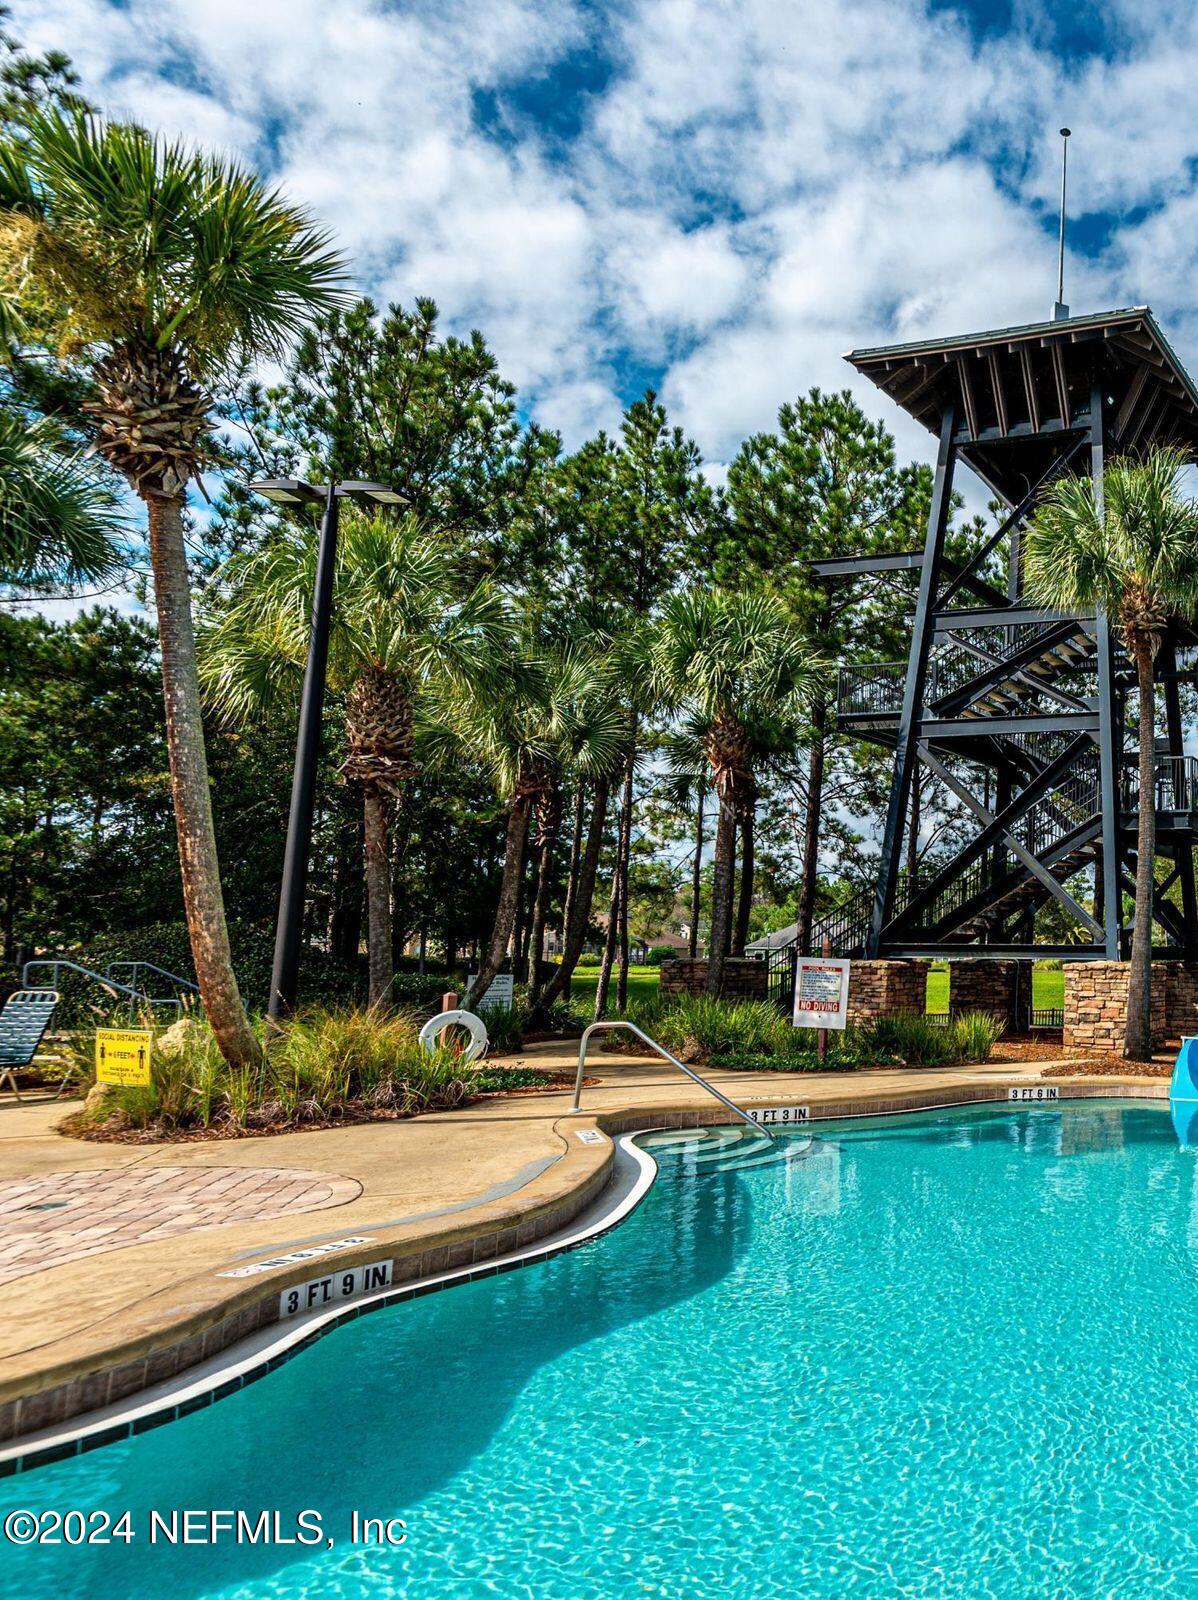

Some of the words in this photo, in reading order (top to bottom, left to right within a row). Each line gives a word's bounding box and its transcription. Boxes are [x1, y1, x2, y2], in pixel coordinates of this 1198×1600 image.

[800, 1001, 810, 1010] NO
[814, 1002, 838, 1012] DIVING
[117, 1034, 150, 1042] DISTANCING
[1012, 1090, 1018, 1098] 3
[1037, 1089, 1043, 1098] 6
[751, 1111, 758, 1121] 3
[783, 1109, 790, 1120] 3
[288, 1290, 299, 1314] 3
[307, 1279, 331, 1307] FT.
[342, 1274, 354, 1296] 9
[364, 1265, 390, 1291] IN.
